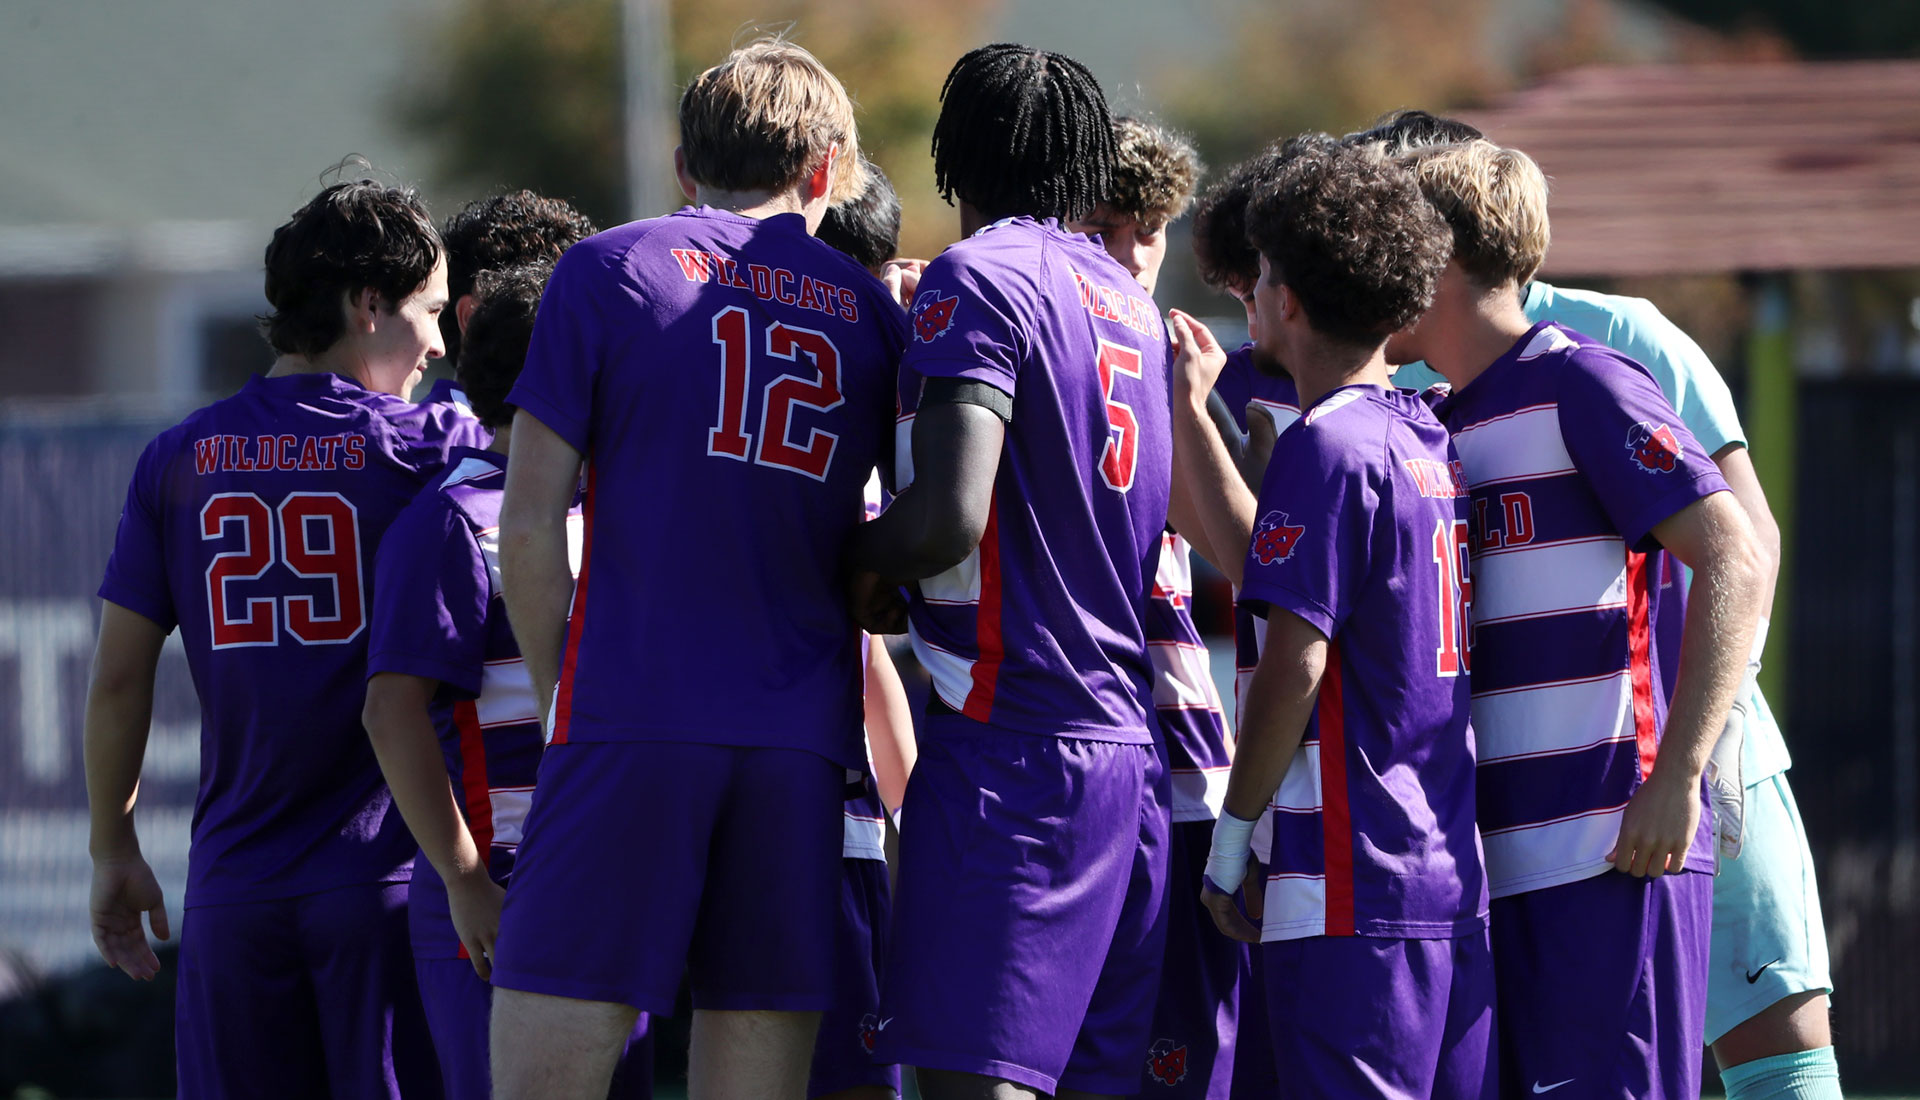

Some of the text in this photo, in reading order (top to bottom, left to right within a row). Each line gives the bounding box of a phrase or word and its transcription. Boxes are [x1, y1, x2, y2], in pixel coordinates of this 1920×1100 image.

[671, 248, 858, 323] WILDCATS
[195, 434, 366, 475] WILDCATS
[707, 305, 845, 483] 12
[1097, 337, 1142, 494] 5
[200, 491, 367, 650] 29
